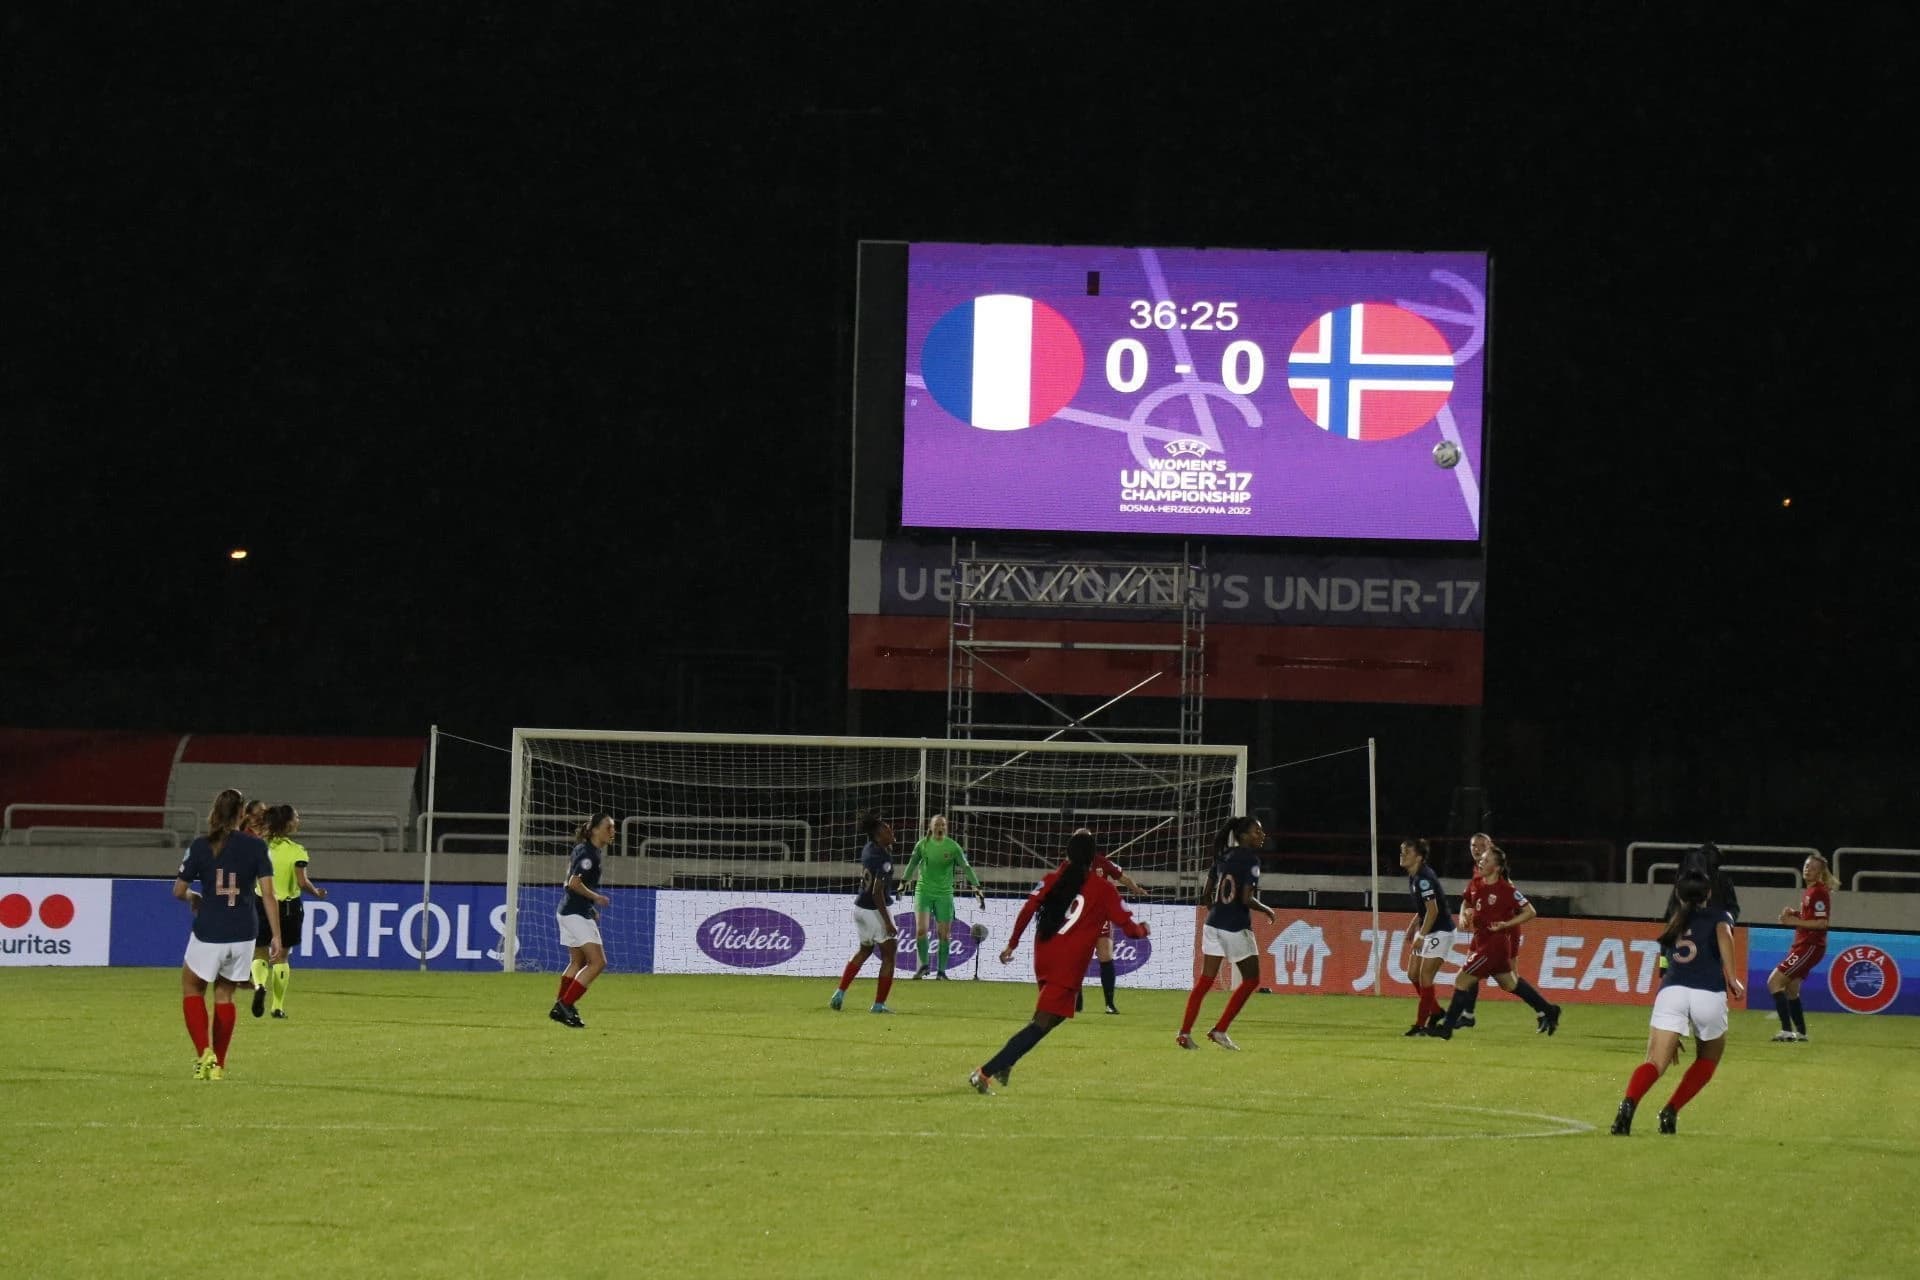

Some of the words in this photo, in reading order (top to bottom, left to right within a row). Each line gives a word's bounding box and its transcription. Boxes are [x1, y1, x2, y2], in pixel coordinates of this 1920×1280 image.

[1129, 300, 1239, 331] 36:25
[1106, 338, 1149, 393] 0
[1221, 340, 1265, 395] 0
[1166, 440, 1208, 456] UEFA
[1148, 458, 1227, 472] WOMEN'S
[1120, 469, 1253, 491] UNDER-17
[1121, 489, 1252, 503] CHAMPIONSHIP
[1119, 504, 1226, 514] BOSNIA-HERZEGOVINA
[1227, 506, 1252, 515] 2022
[1264, 575, 1481, 615] UNDER-17
[215, 868, 240, 907] 4
[1057, 894, 1085, 935] 9
[272, 900, 520, 961] RIFOLS
[709, 921, 793, 951] Violeta
[0, 933, 71, 955] uritas
[1430, 937, 1440, 951] 9
[1843, 948, 1886, 966] UEFA
[1352, 928, 1526, 992] JUS
[1537, 935, 1662, 994] EAT
